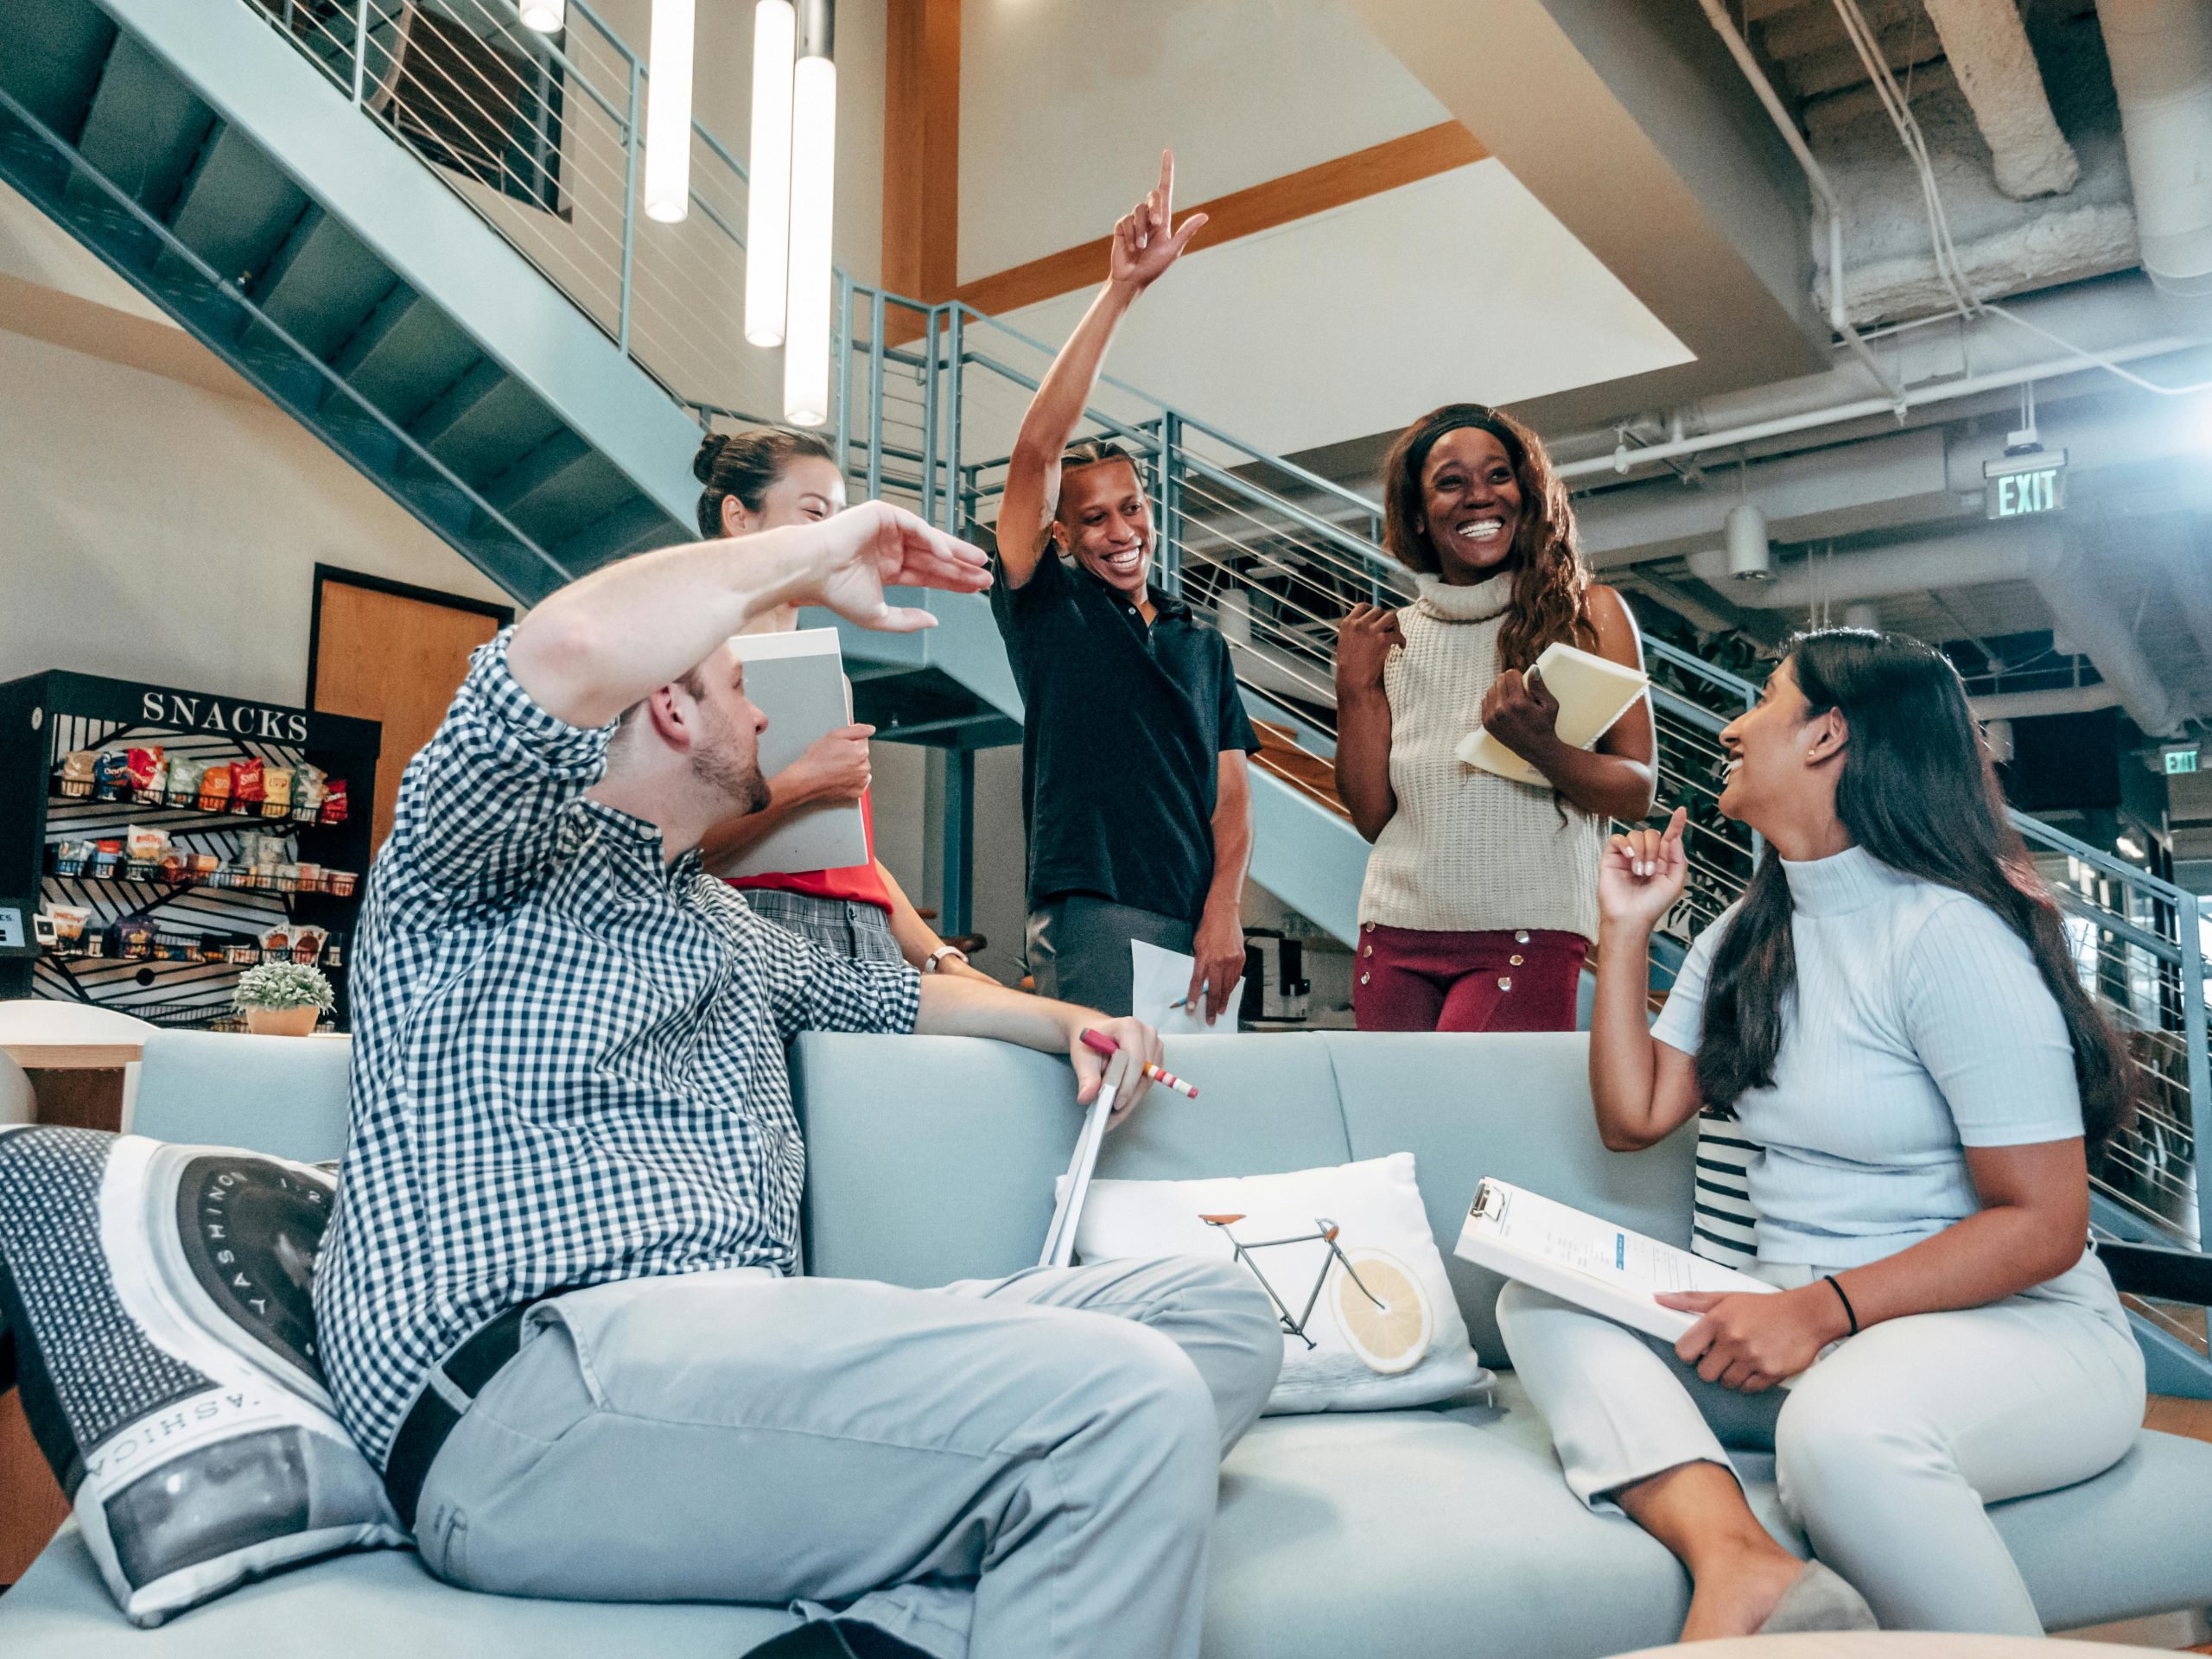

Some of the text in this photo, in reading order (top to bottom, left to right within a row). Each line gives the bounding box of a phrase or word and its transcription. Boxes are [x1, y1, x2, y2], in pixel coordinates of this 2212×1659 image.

[1999, 469, 2056, 516] EXIT
[143, 692, 308, 742] SNACKS
[2165, 750, 2197, 774] EXIT
